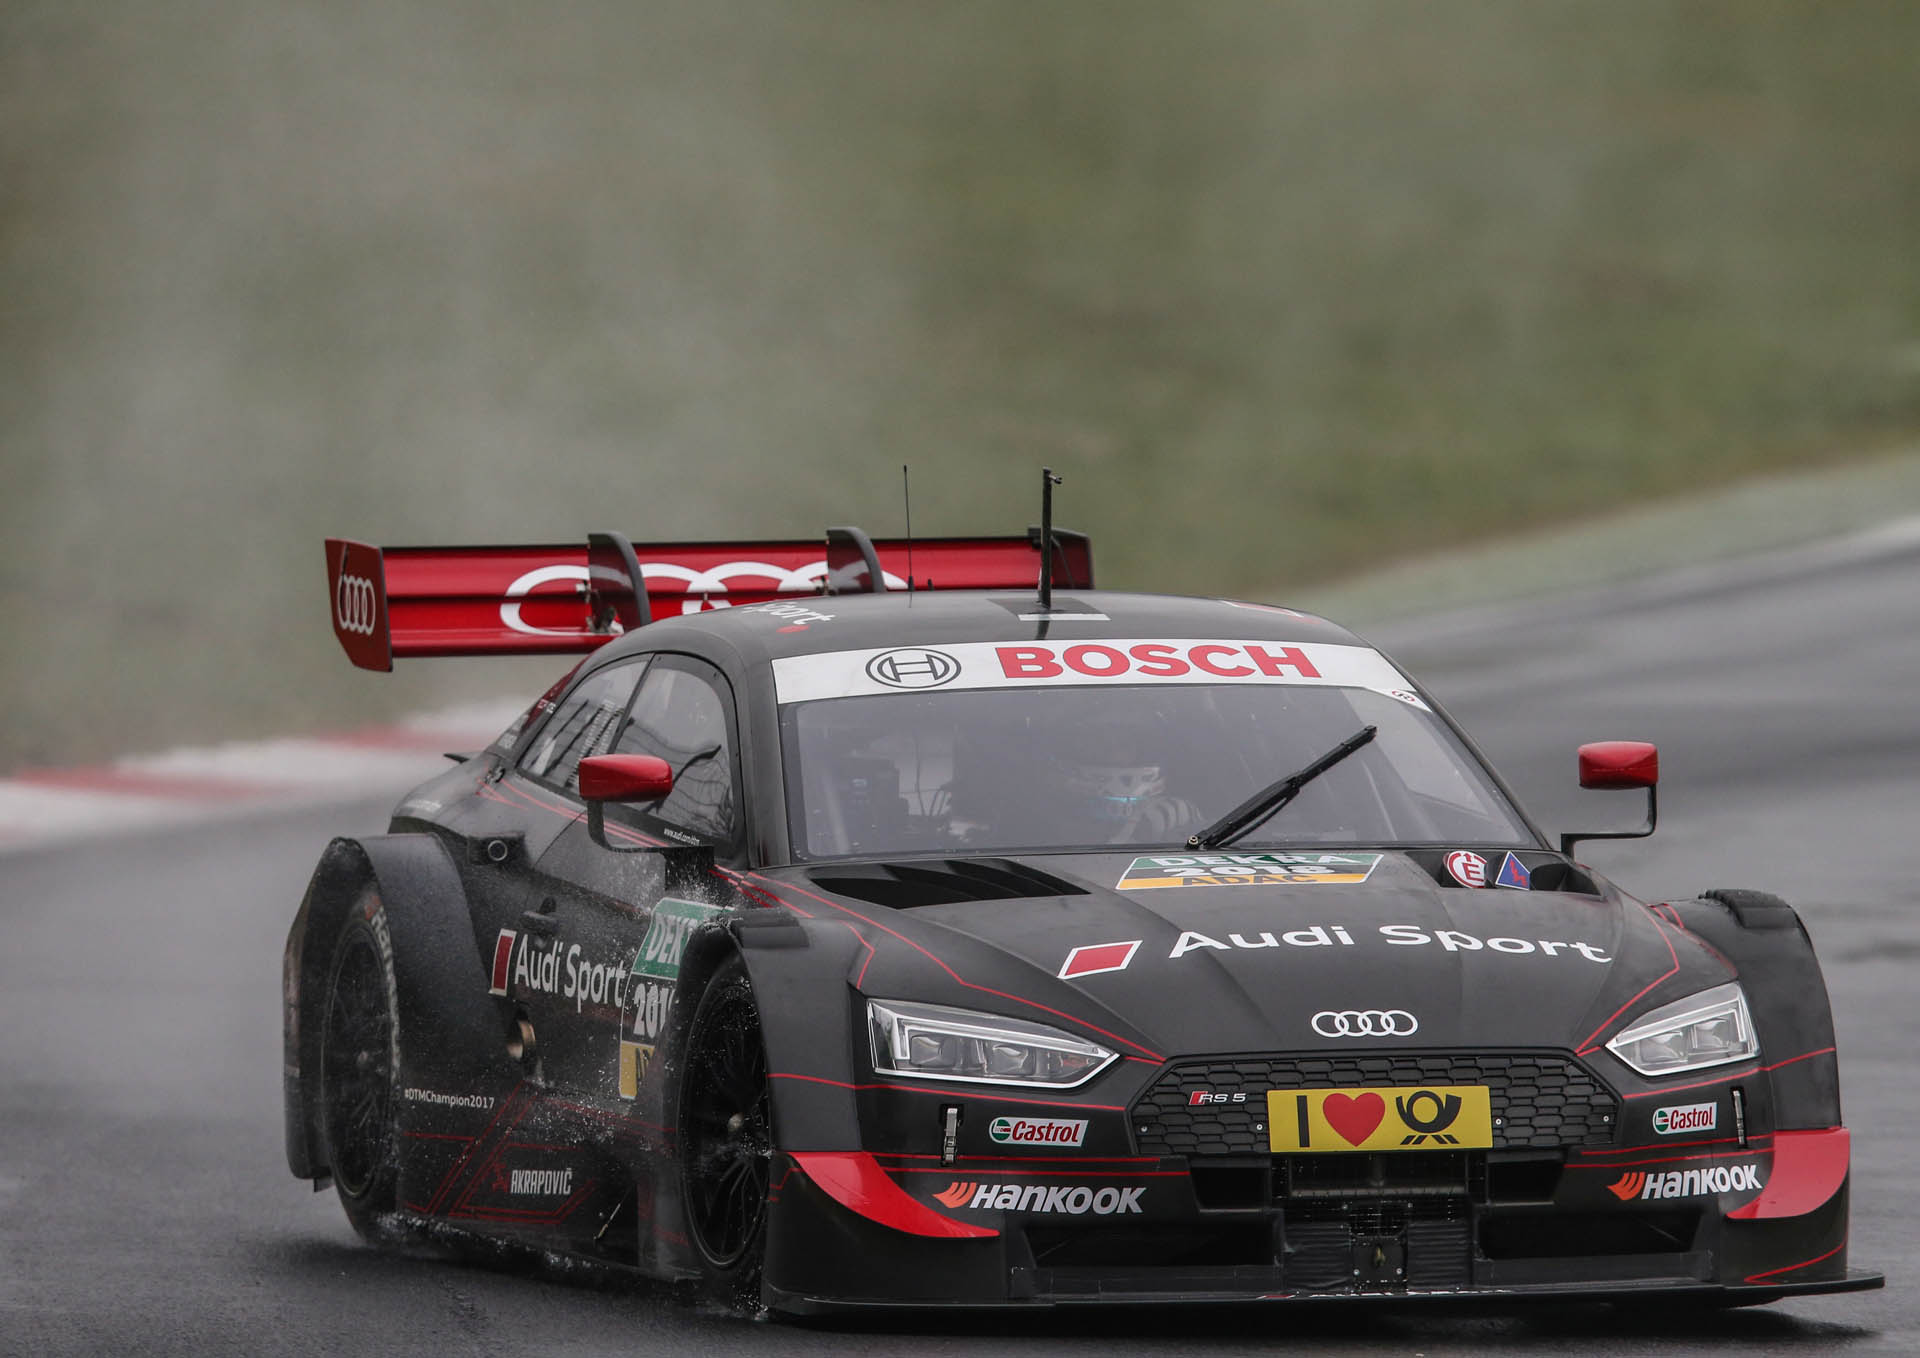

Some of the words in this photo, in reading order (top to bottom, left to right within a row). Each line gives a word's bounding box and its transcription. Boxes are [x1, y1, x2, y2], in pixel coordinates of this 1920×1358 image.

[995, 644, 1322, 678] BOSCH
[1150, 854, 1361, 867] DEKRA
[1163, 865, 1335, 877] 2018
[1182, 874, 1317, 886] ADAC
[1168, 926, 1355, 959] Audi
[1379, 925, 1612, 963] Sport
[515, 934, 563, 993] Audi
[564, 944, 626, 1013] Sport
[633, 983, 677, 1038] 201
[404, 1087, 494, 1110] #DTMChampion2017
[1198, 1093, 1229, 1103] RS
[1232, 1093, 1247, 1103] 5
[1296, 1095, 1310, 1148] I
[1670, 1106, 1714, 1130] Castrol
[1012, 1121, 1081, 1142] Castrol
[511, 1167, 573, 1196] AKRAPOVIČ
